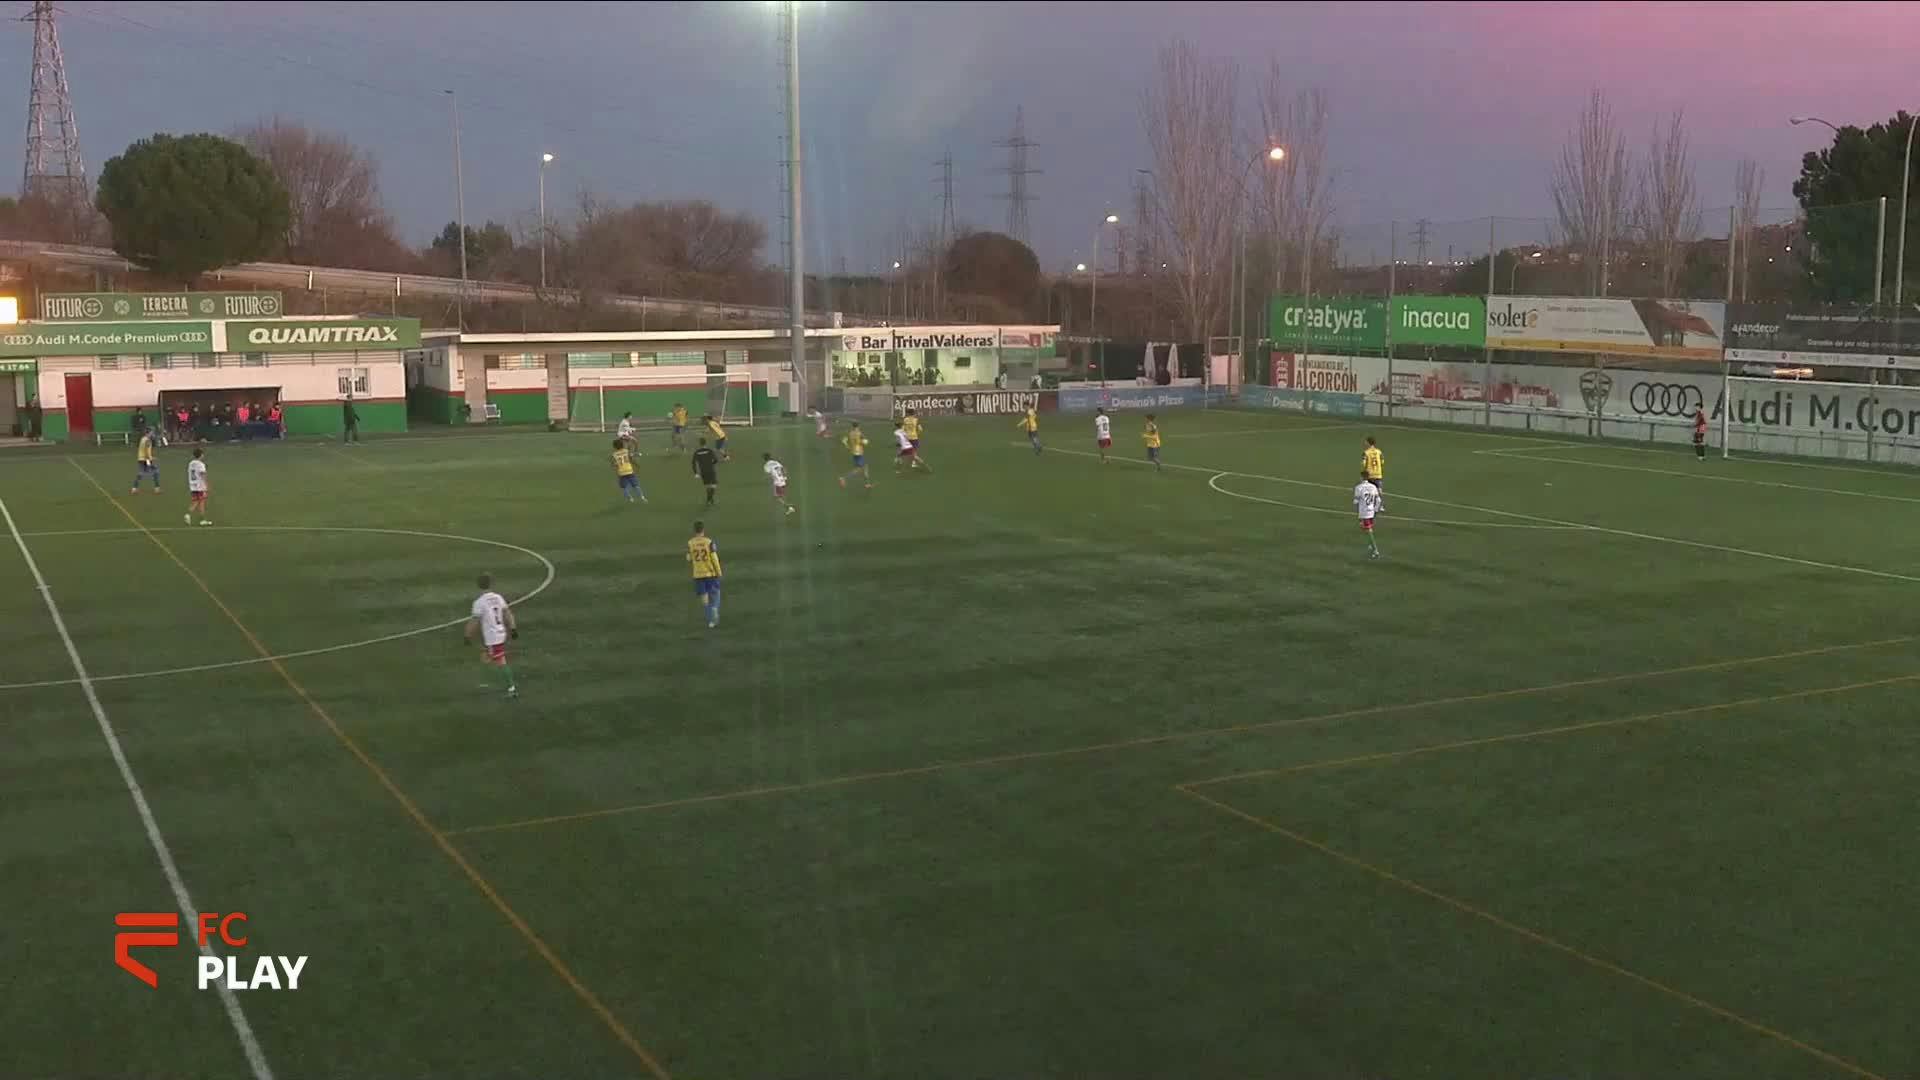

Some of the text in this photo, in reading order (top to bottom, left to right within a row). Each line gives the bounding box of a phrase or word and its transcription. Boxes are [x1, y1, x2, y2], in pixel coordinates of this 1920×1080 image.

[143, 297, 188, 312] TERCERA
[1403, 305, 1470, 329] inacua
[36, 332, 178, 346] Audi M.Conde Premium
[248, 326, 398, 344] QUAMTRAX
[861, 336, 887, 349] Bar
[895, 334, 993, 349] TrivalValderas
[1296, 368, 1357, 392] ALCORCÓN
[1711, 389, 1792, 425] Audi
